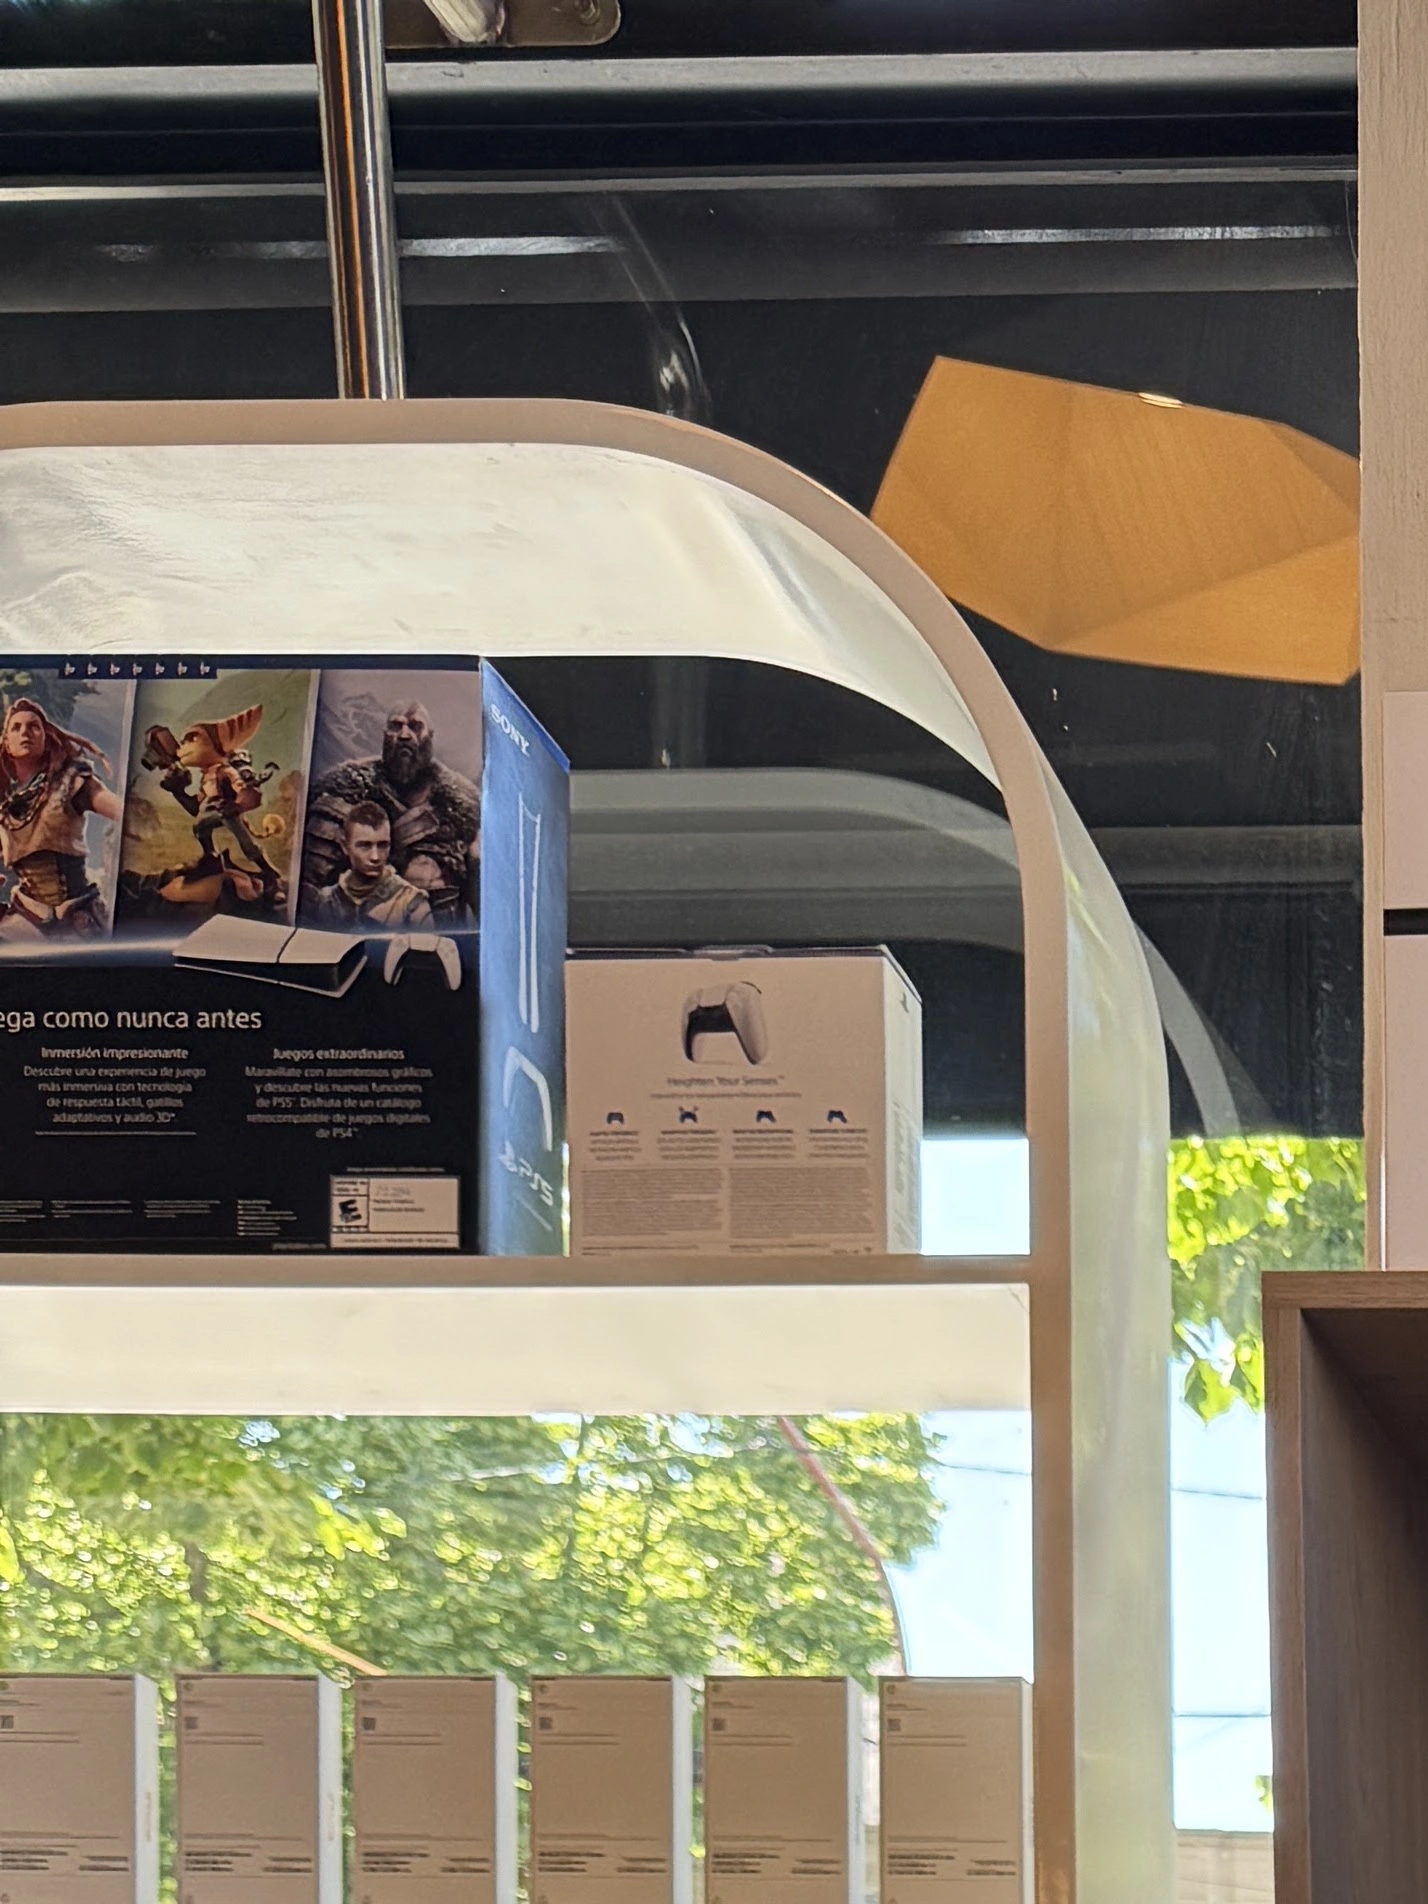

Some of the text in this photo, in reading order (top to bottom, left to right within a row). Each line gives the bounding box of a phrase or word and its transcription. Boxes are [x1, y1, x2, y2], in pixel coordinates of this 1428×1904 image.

[491, 703, 530, 758] SONY
[43, 1011, 109, 1029] como
[117, 1011, 189, 1029] nunca
[196, 1009, 262, 1029] antes
[41, 1047, 188, 1060] Inmersión impresionante
[273, 1048, 405, 1061] Juegos extraordinarios
[667, 1077, 714, 1088] Heighten
[716, 1076, 739, 1086] Your
